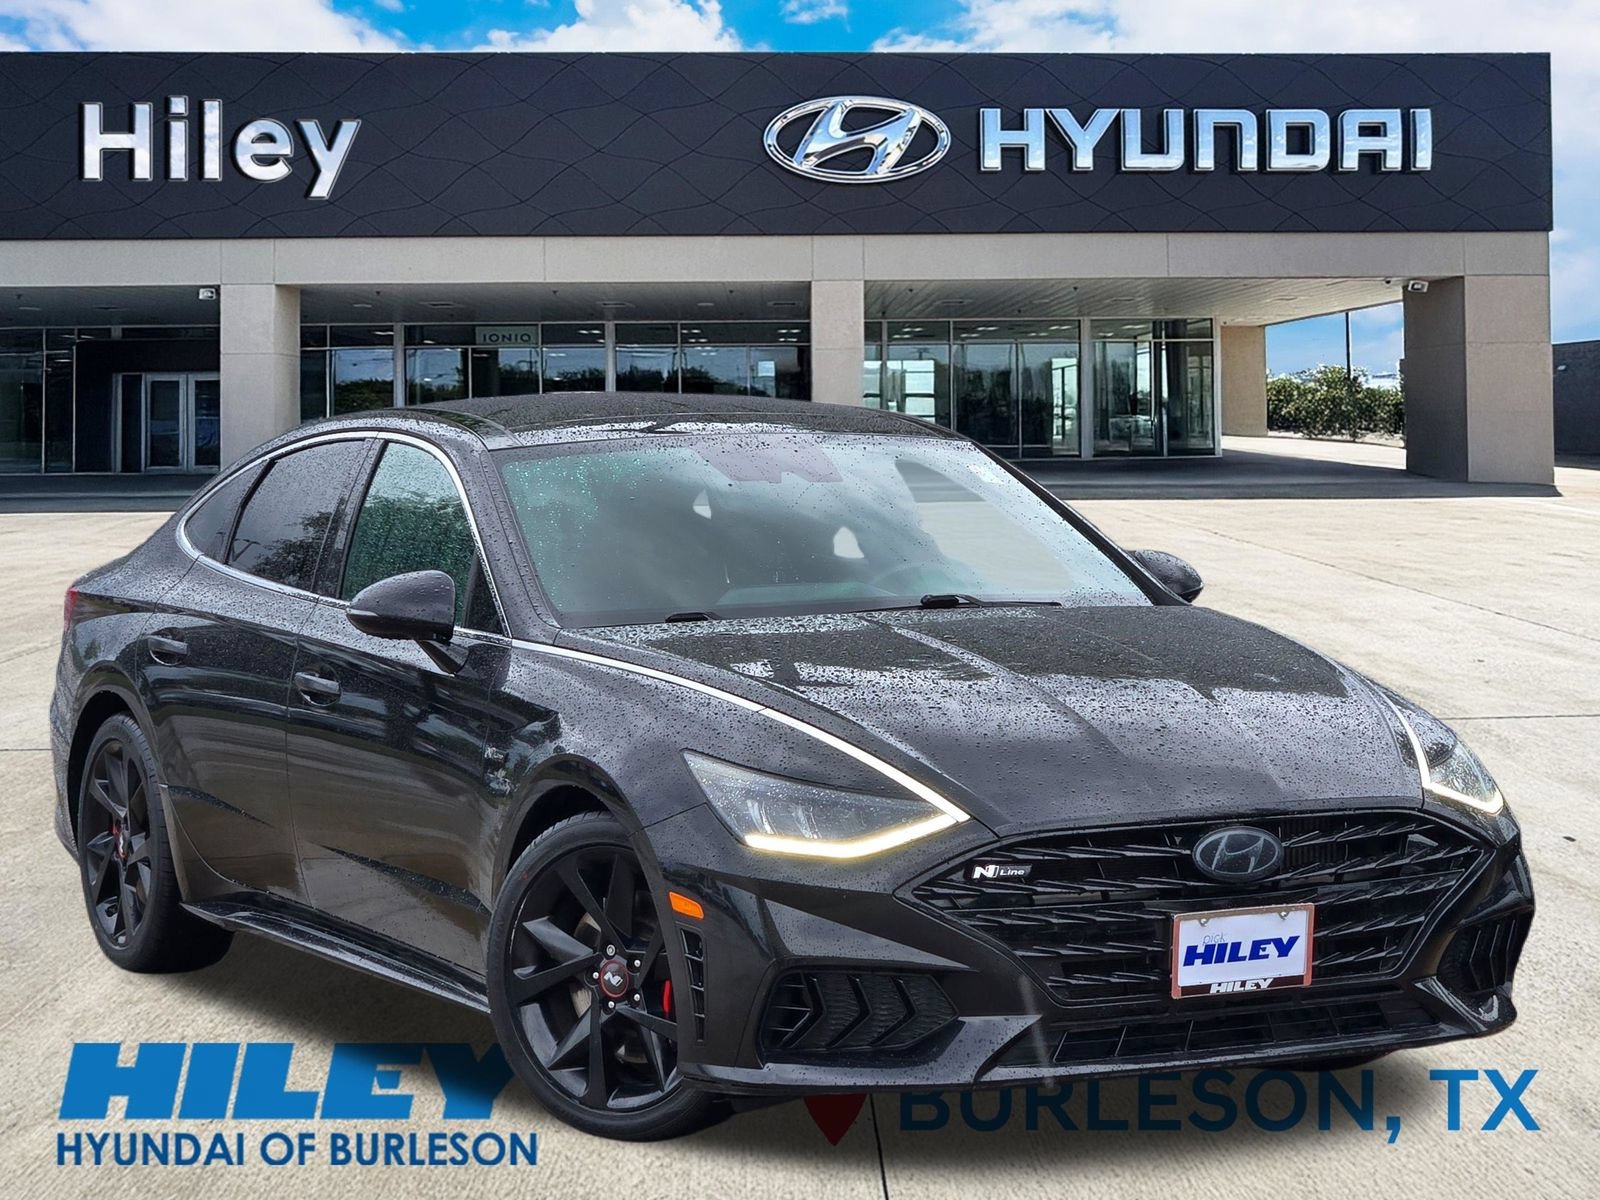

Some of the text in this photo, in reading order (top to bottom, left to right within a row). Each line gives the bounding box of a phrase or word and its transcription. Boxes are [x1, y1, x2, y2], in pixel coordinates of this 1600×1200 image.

[80, 95, 361, 199] Hiley
[979, 107, 1433, 172] HYUNDAI
[1182, 935, 1301, 967] HILEY
[1209, 978, 1274, 994] HILEY
